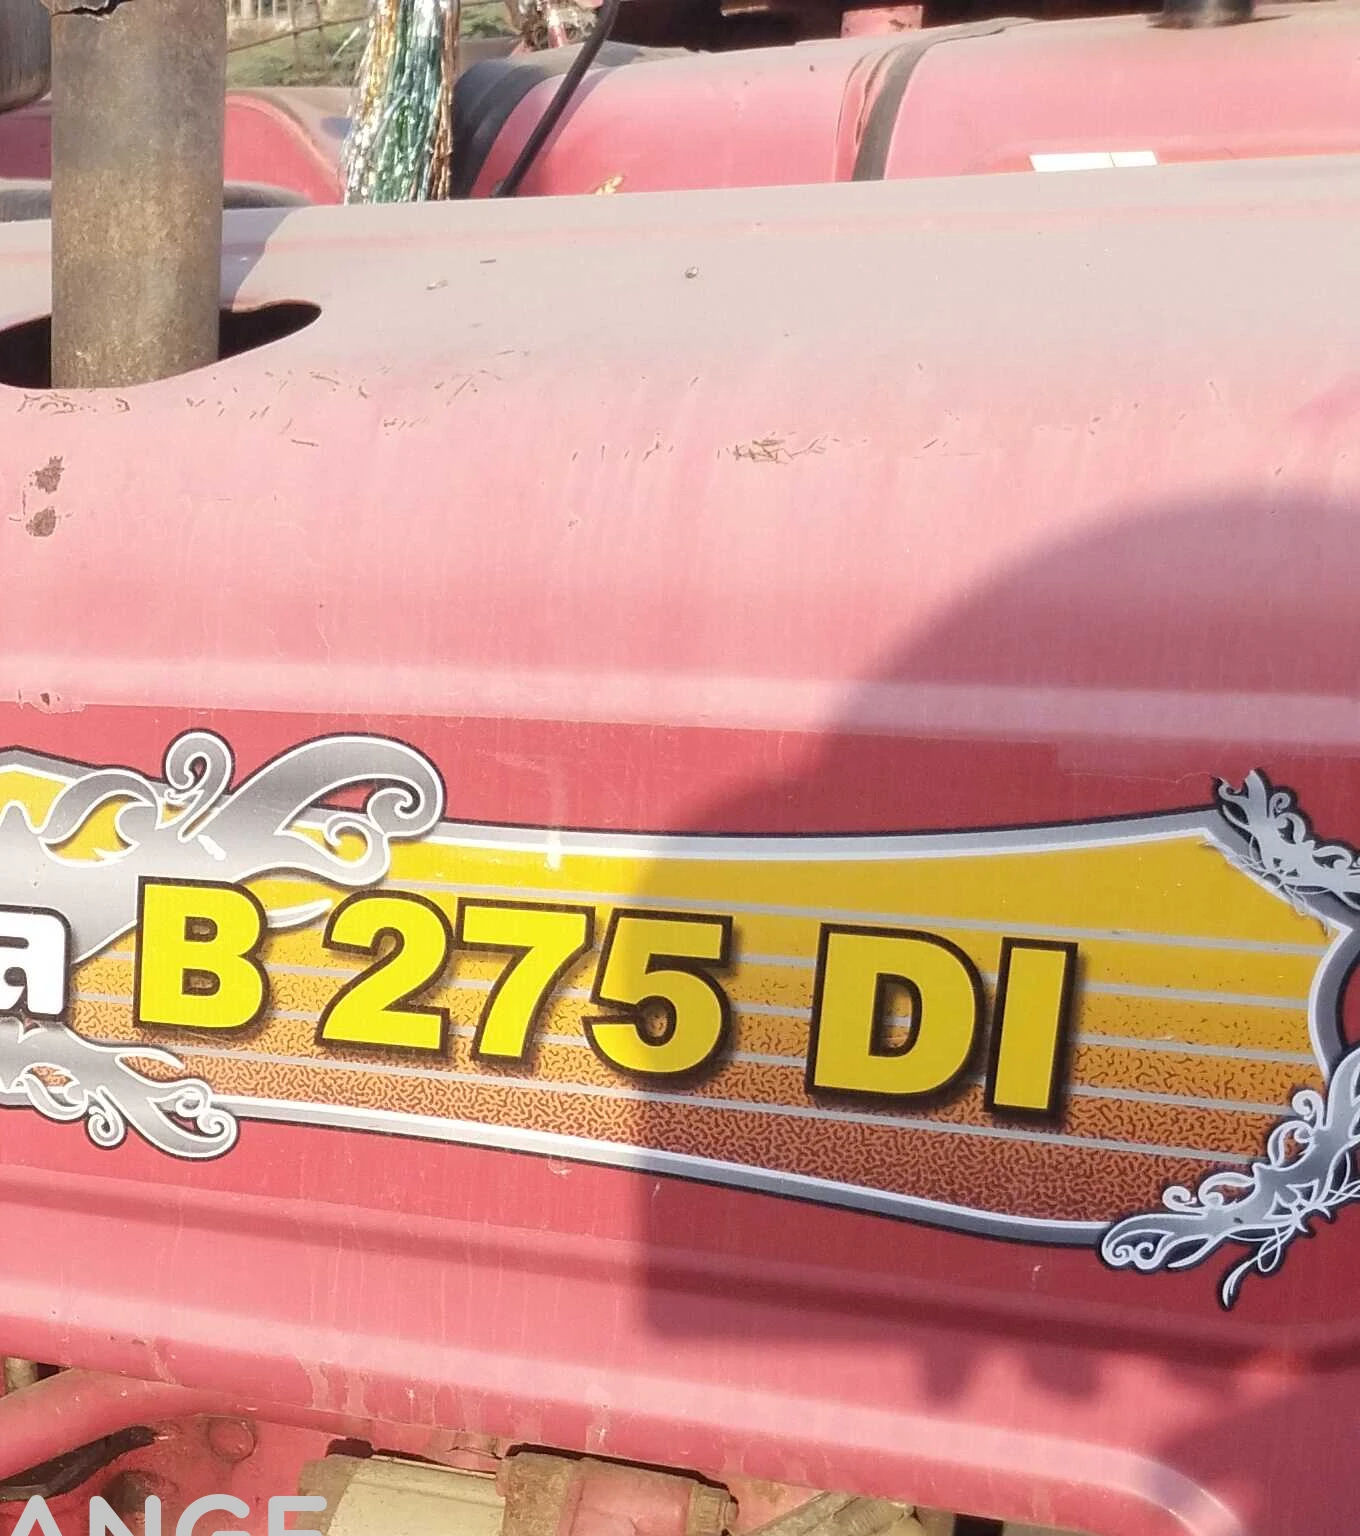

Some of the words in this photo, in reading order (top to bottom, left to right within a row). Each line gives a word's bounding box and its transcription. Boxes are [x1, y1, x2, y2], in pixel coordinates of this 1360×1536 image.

[132, 876, 271, 1033] B
[314, 890, 736, 1078] 275
[806, 922, 1079, 1114] DI
